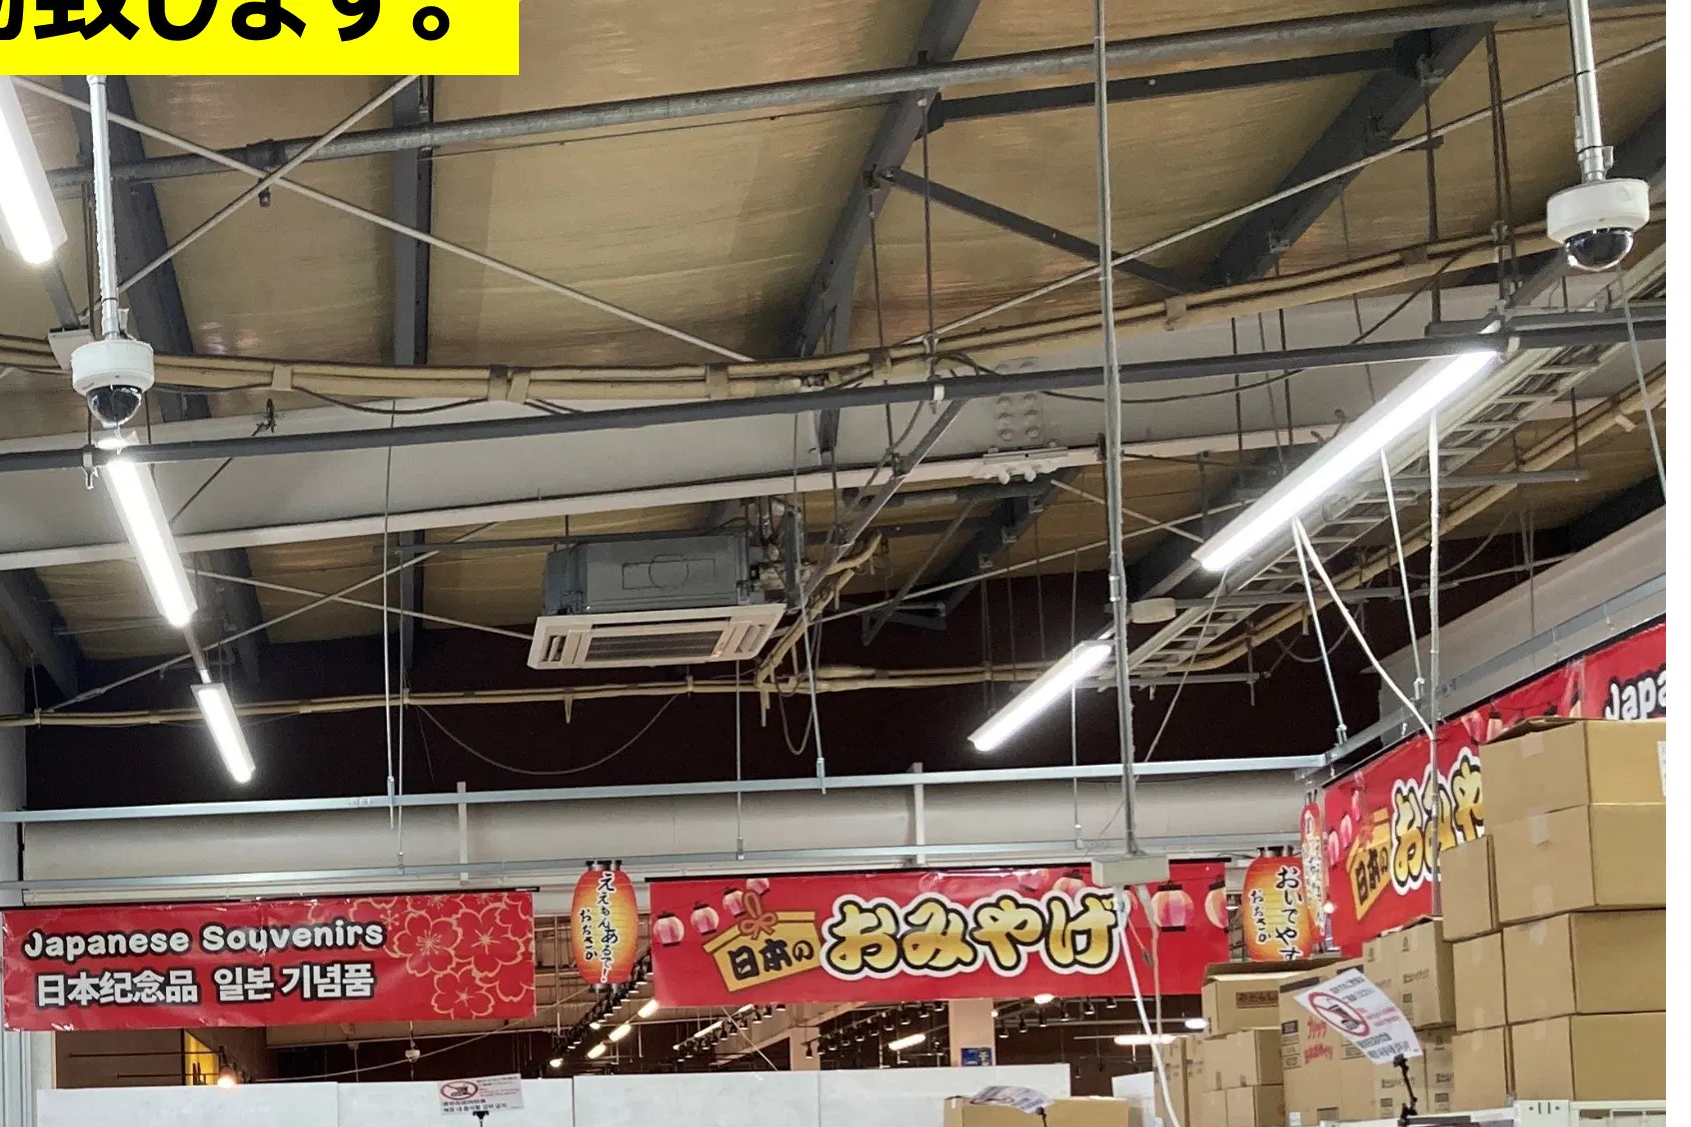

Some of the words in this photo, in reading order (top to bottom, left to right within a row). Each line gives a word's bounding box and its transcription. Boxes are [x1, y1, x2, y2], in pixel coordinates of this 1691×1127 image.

[1355, 846, 1389, 906] 日本の
[23, 931, 190, 962] Japanese
[201, 918, 385, 953] Souvenirs
[579, 907, 599, 961] おおさか
[826, 892, 1120, 976] おみやげ
[1250, 889, 1272, 943] おおさか
[215, 965, 274, 1001] 일본
[281, 962, 375, 999] 기념품
[726, 938, 814, 982] 日本の
[35, 969, 198, 1008] 日本纪念品
